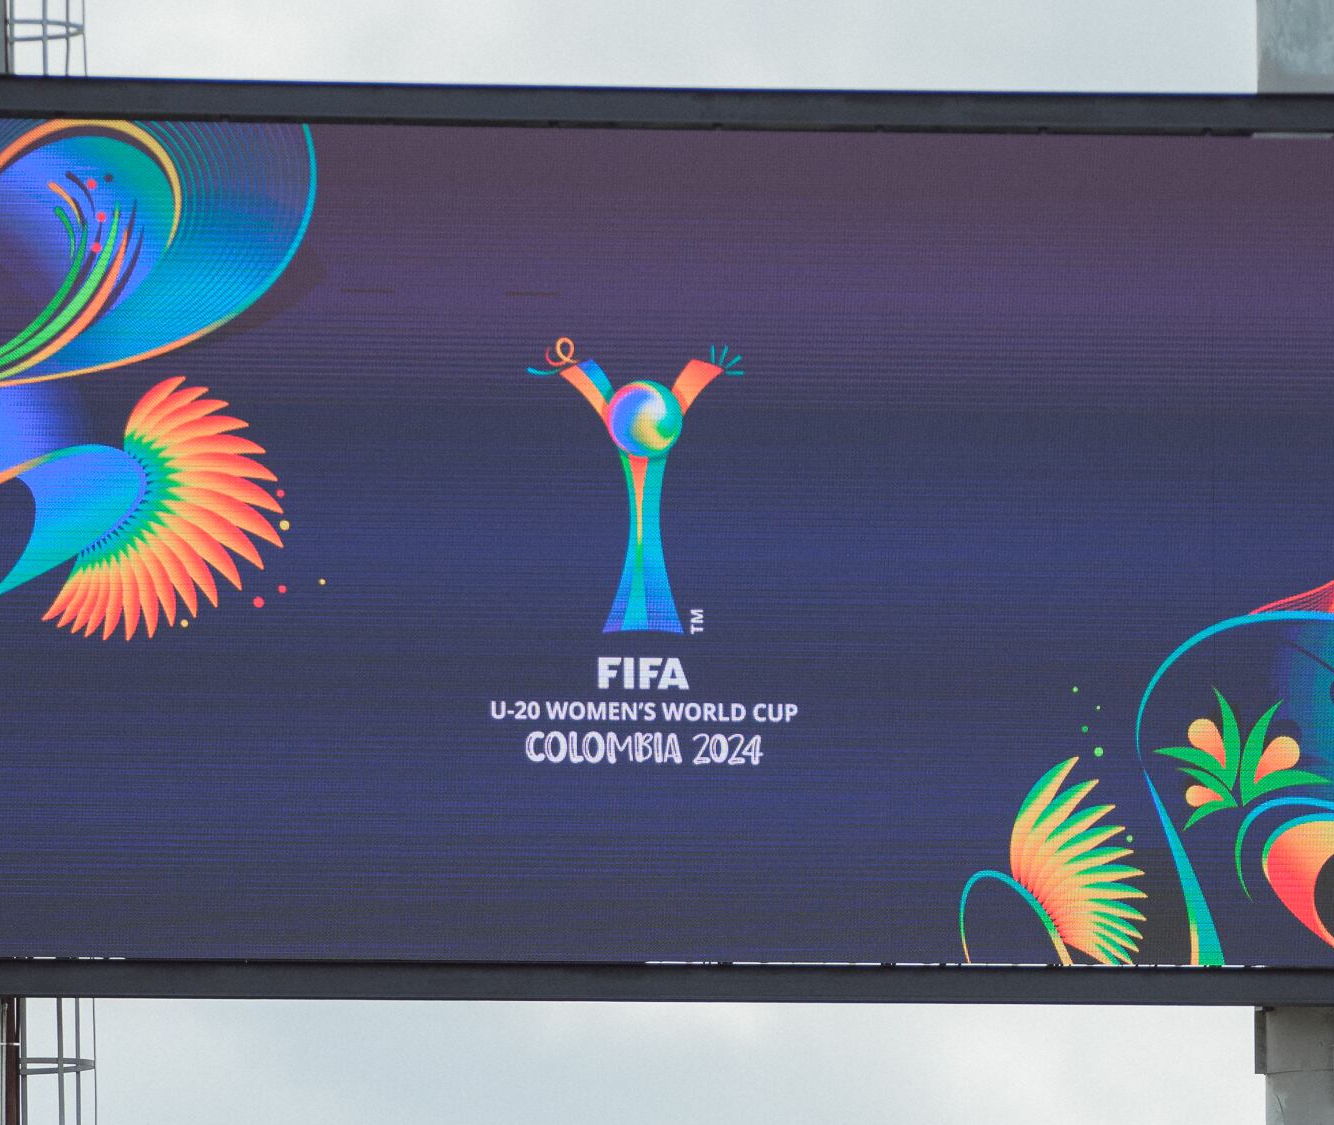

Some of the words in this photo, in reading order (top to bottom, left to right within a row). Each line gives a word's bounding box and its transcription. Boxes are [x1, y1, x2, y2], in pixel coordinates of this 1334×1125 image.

[690, 609, 704, 634] TM
[598, 657, 689, 690] FIFA
[491, 701, 540, 720] U-20
[546, 701, 656, 721] WOMEN'S
[662, 702, 746, 722] WORLD
[753, 703, 798, 722] CUP
[526, 731, 682, 764] COLOMBIA
[693, 733, 763, 765] 2024
